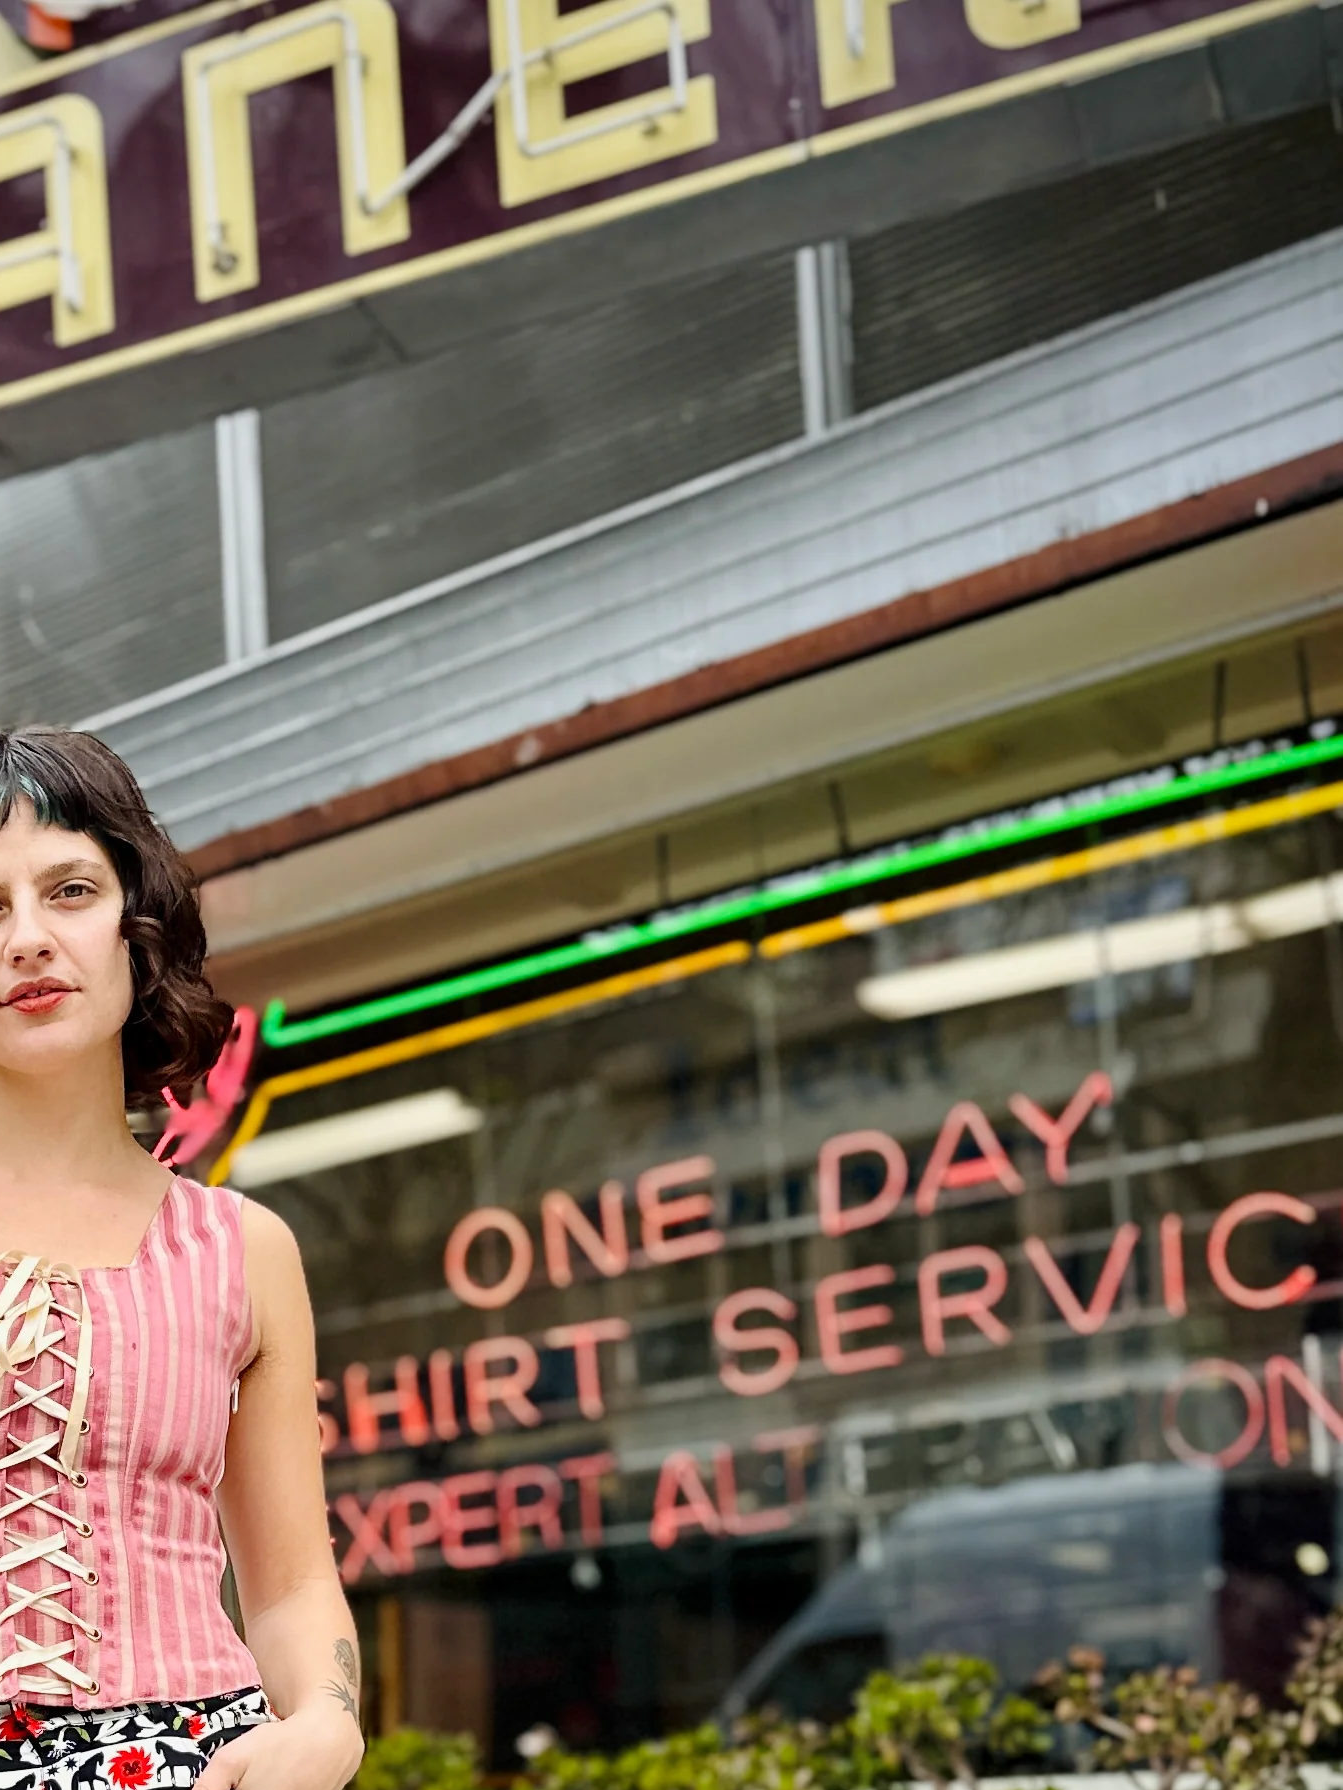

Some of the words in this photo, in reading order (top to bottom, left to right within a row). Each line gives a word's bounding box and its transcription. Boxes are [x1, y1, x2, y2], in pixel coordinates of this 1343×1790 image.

[444, 1154, 725, 1309] ONE
[818, 1070, 1113, 1237] DAY
[712, 1191, 1343, 1397] SERVIC
[324, 1451, 617, 1586] XPERT
